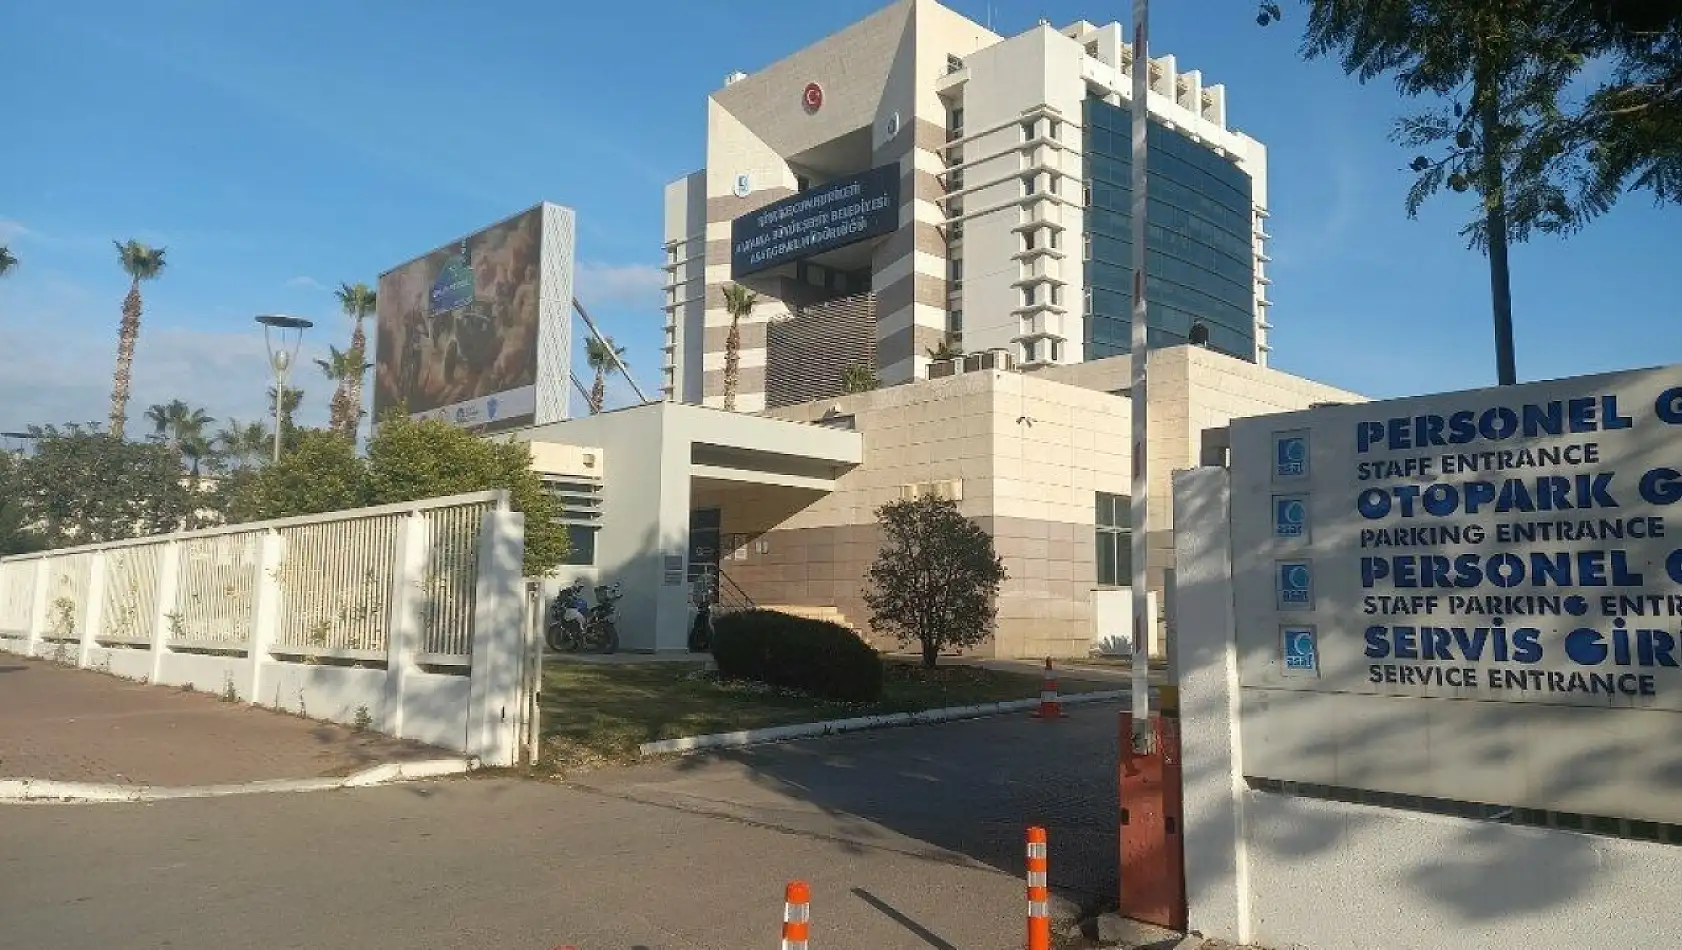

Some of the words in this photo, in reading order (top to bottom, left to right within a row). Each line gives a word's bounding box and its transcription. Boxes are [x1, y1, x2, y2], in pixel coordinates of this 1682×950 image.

[1358, 396, 1633, 454] PERSONEL
[1358, 457, 1432, 480] STAFF
[1442, 443, 1599, 474] ENTRANCE
[1358, 471, 1620, 519] OTOPARK
[1639, 468, 1682, 505] G
[1361, 524, 1485, 548] PARKING
[1496, 517, 1665, 543] ENTRANCE
[1361, 550, 1643, 588] PERSONEL
[1363, 595, 1438, 615] STAFF
[1448, 595, 1589, 616] PARKING
[1364, 617, 1544, 663] SERVİS
[1565, 617, 1682, 667] GİR
[1369, 664, 1478, 687] SERVICE
[1488, 669, 1656, 696] ENTRANCE
